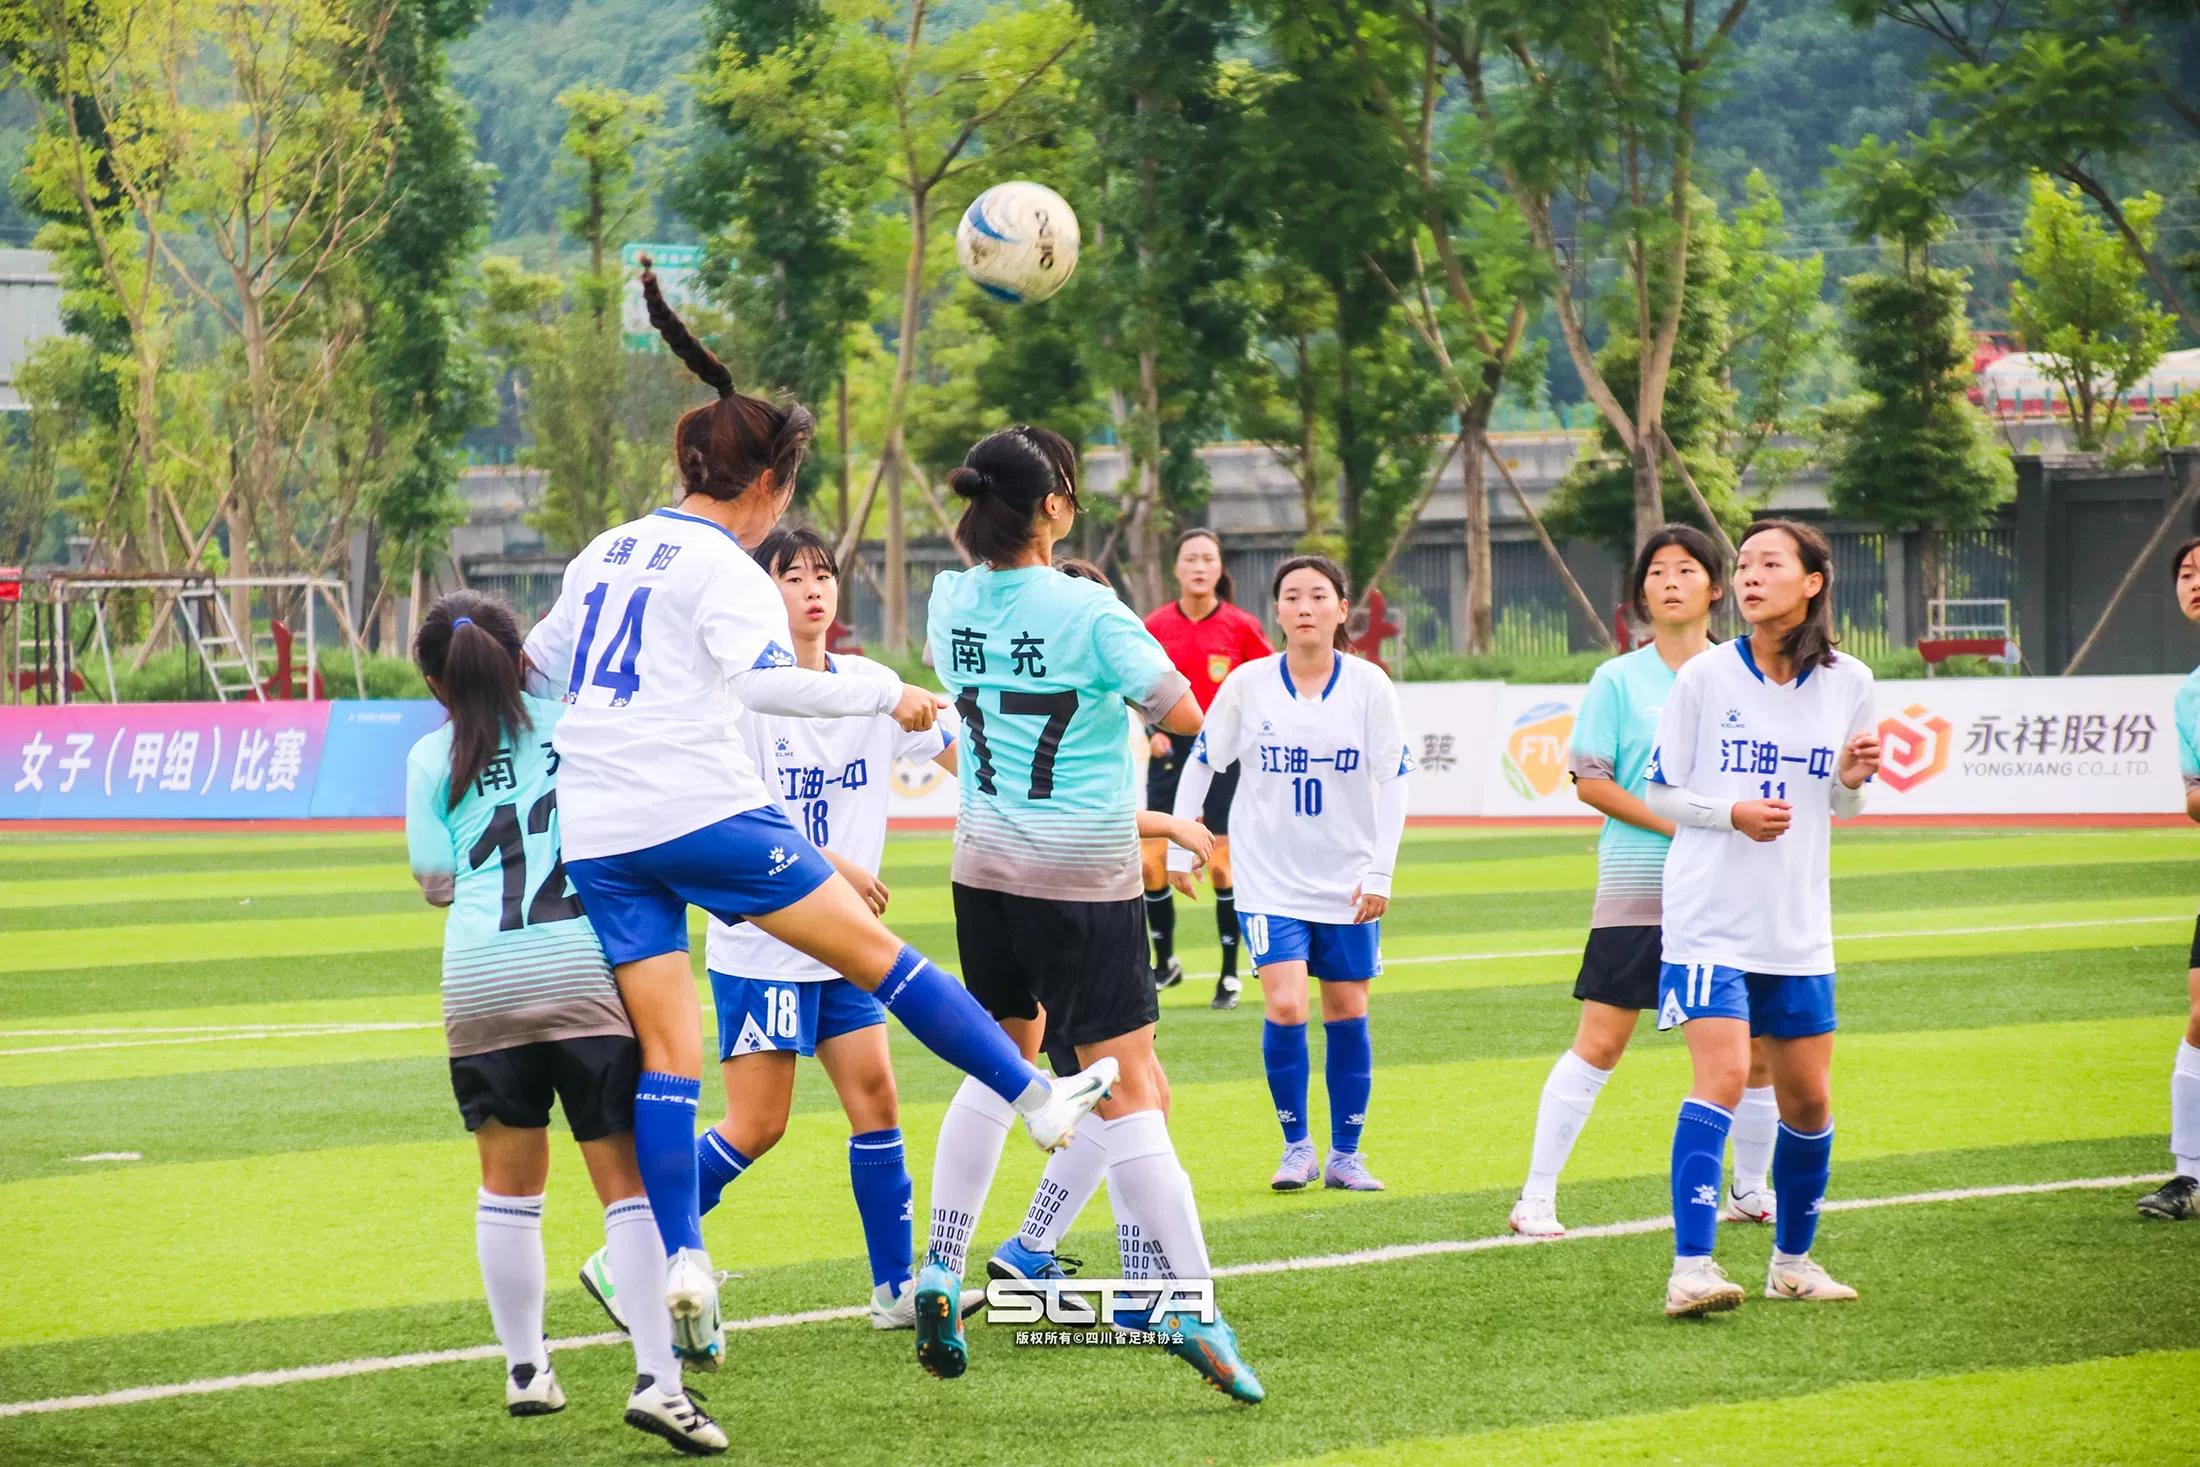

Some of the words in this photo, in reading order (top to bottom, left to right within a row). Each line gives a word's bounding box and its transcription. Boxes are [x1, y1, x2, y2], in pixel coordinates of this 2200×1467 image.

[603, 536, 682, 570] 绵阳
[569, 582, 653, 707] 14
[951, 627, 1047, 679] 南充
[954, 686, 1080, 800] 17
[1963, 714, 2157, 756] 永祥股份
[778, 758, 868, 801] 江油一中
[1260, 745, 1360, 773] 江油一中
[1720, 739, 1835, 779] 江油一中
[1962, 761, 2073, 777] YONGXIANG
[1292, 777, 1322, 817] 10
[803, 799, 829, 848] 18
[768, 852, 800, 877] KELME
[1686, 964, 1714, 1008] 11
[764, 986, 797, 1038] 18
